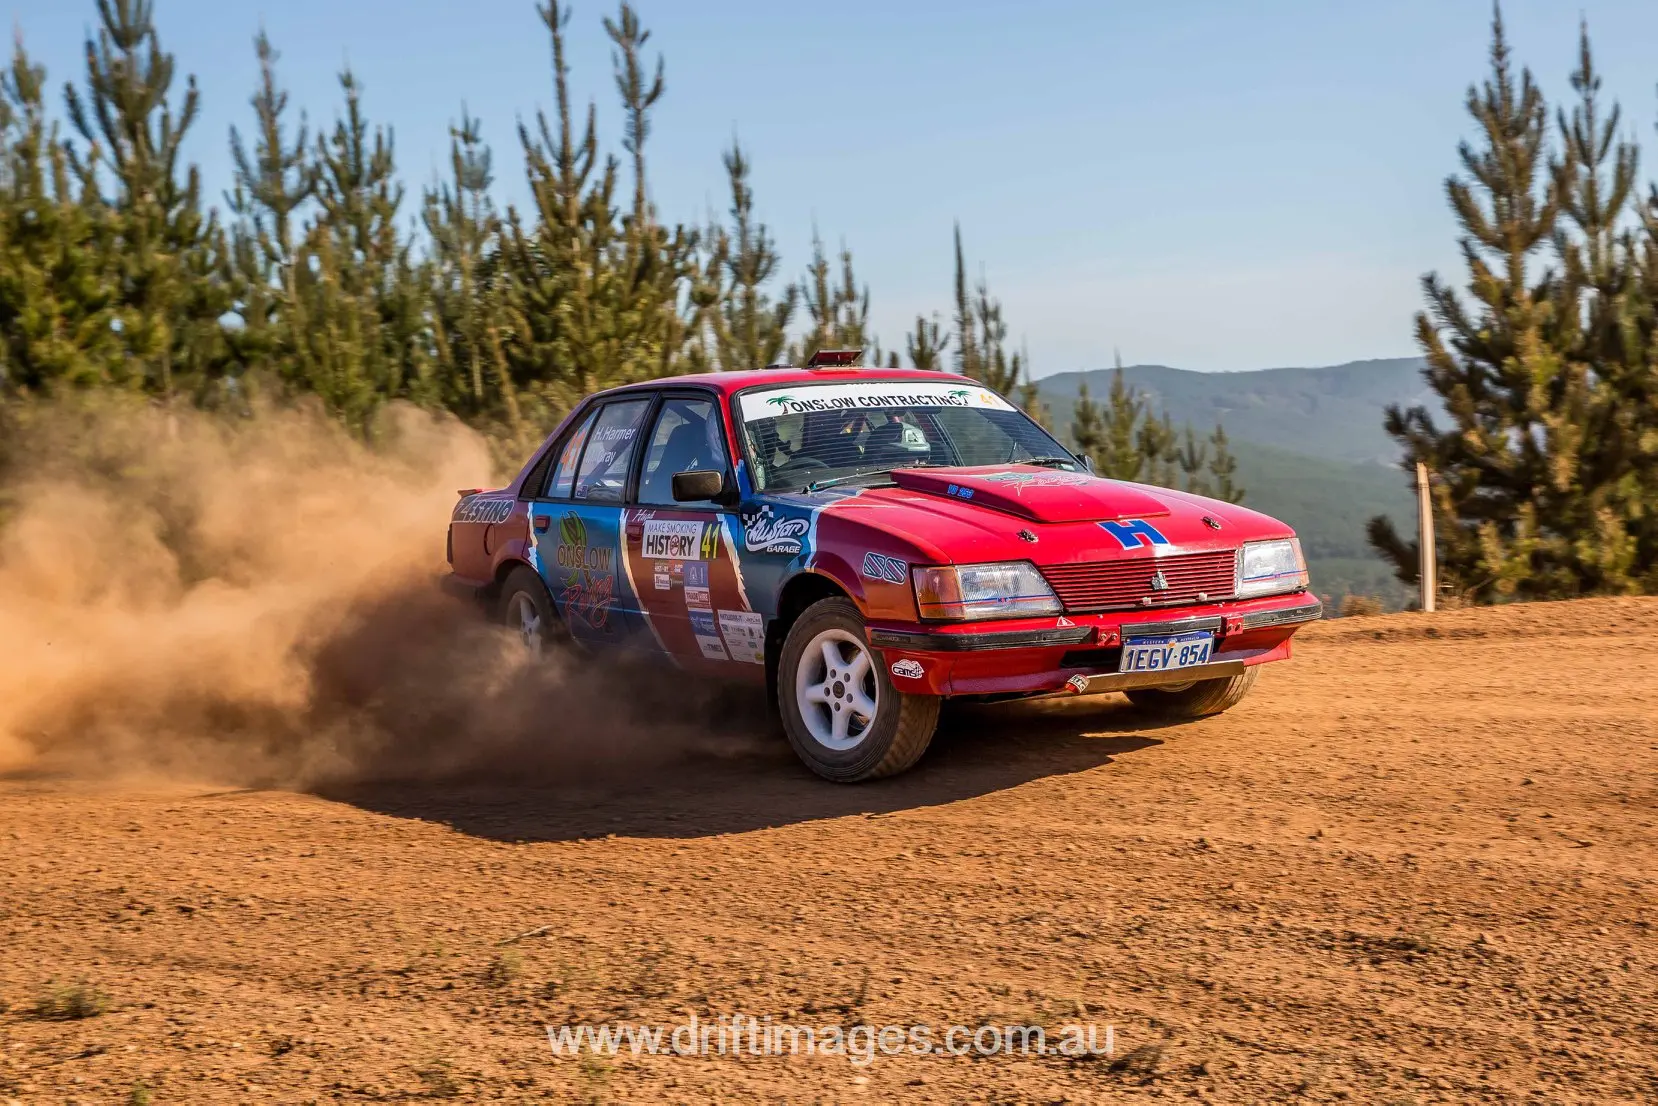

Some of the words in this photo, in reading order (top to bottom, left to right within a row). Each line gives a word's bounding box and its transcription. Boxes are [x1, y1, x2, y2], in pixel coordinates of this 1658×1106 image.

[790, 396, 856, 413] ONSLOW
[859, 394, 963, 407] CONTRACTING
[647, 523, 666, 533] MAKE
[666, 524, 697, 534] SMOKING
[646, 535, 696, 557] HISTORY
[701, 523, 720, 559] 41
[766, 544, 801, 554] GARAGE
[557, 544, 613, 571] ONSLOW
